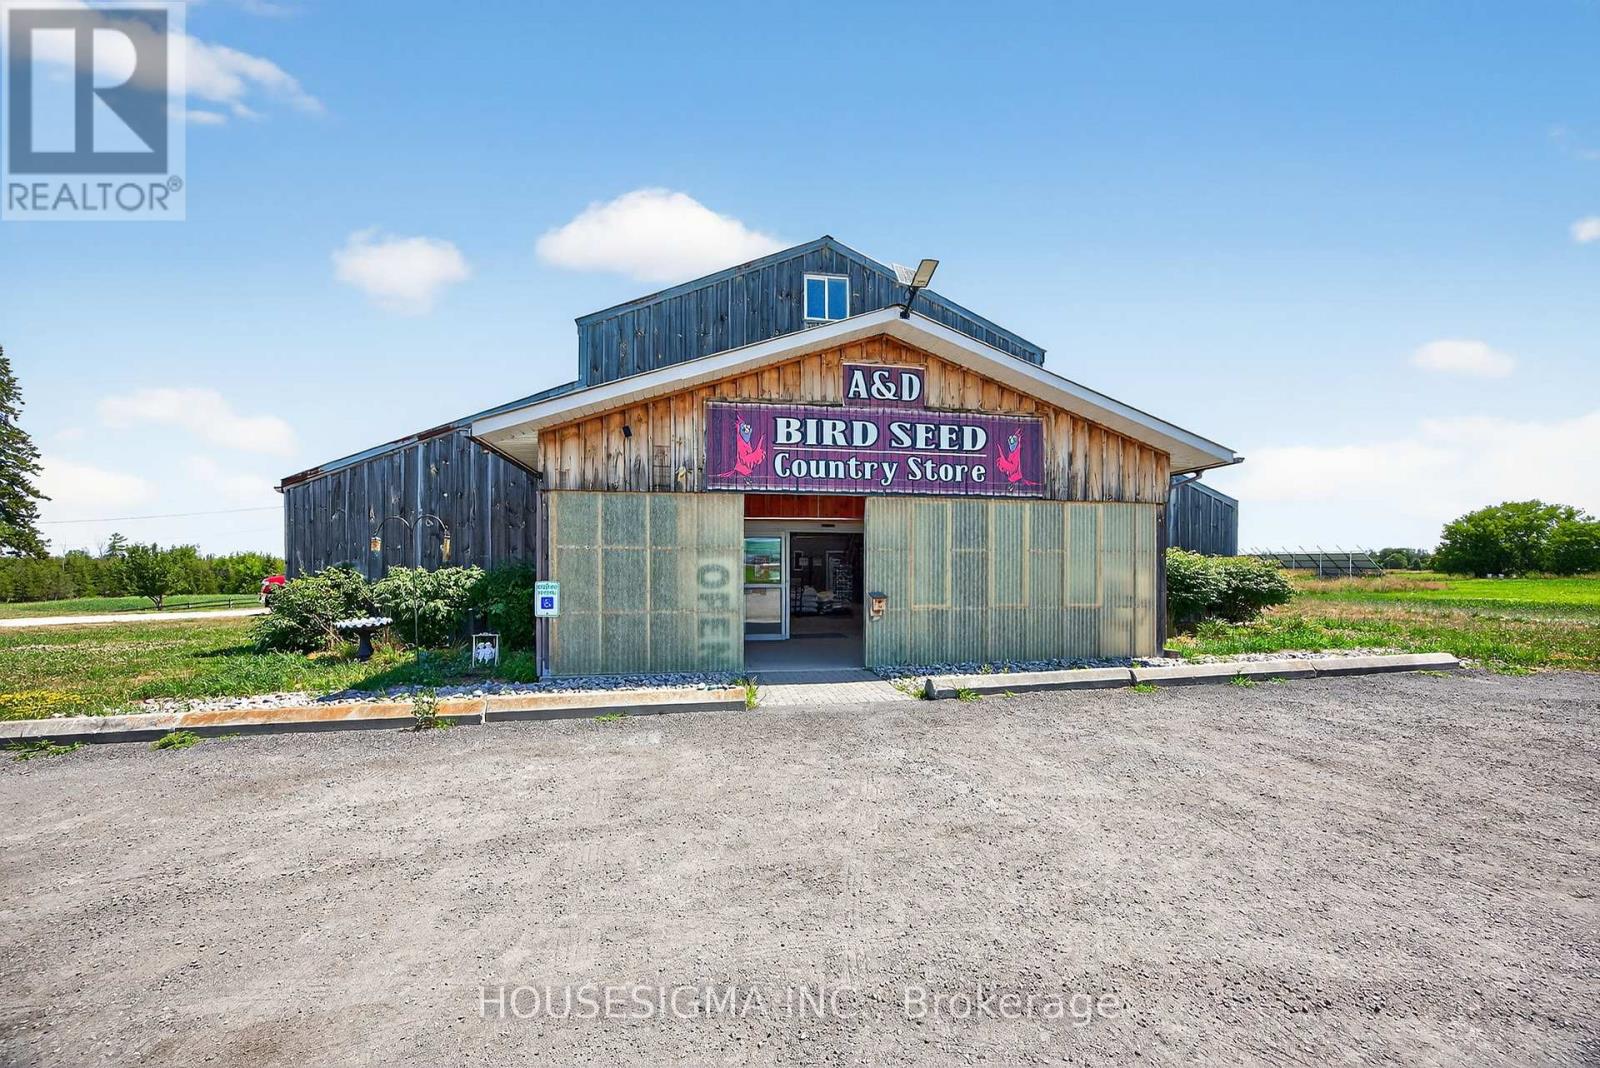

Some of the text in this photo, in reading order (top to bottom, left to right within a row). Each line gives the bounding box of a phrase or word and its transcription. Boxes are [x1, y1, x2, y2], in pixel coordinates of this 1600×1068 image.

[848, 369, 922, 401] A&D
[774, 417, 987, 452] BIRD SEED
[774, 453, 986, 486] Country Store
